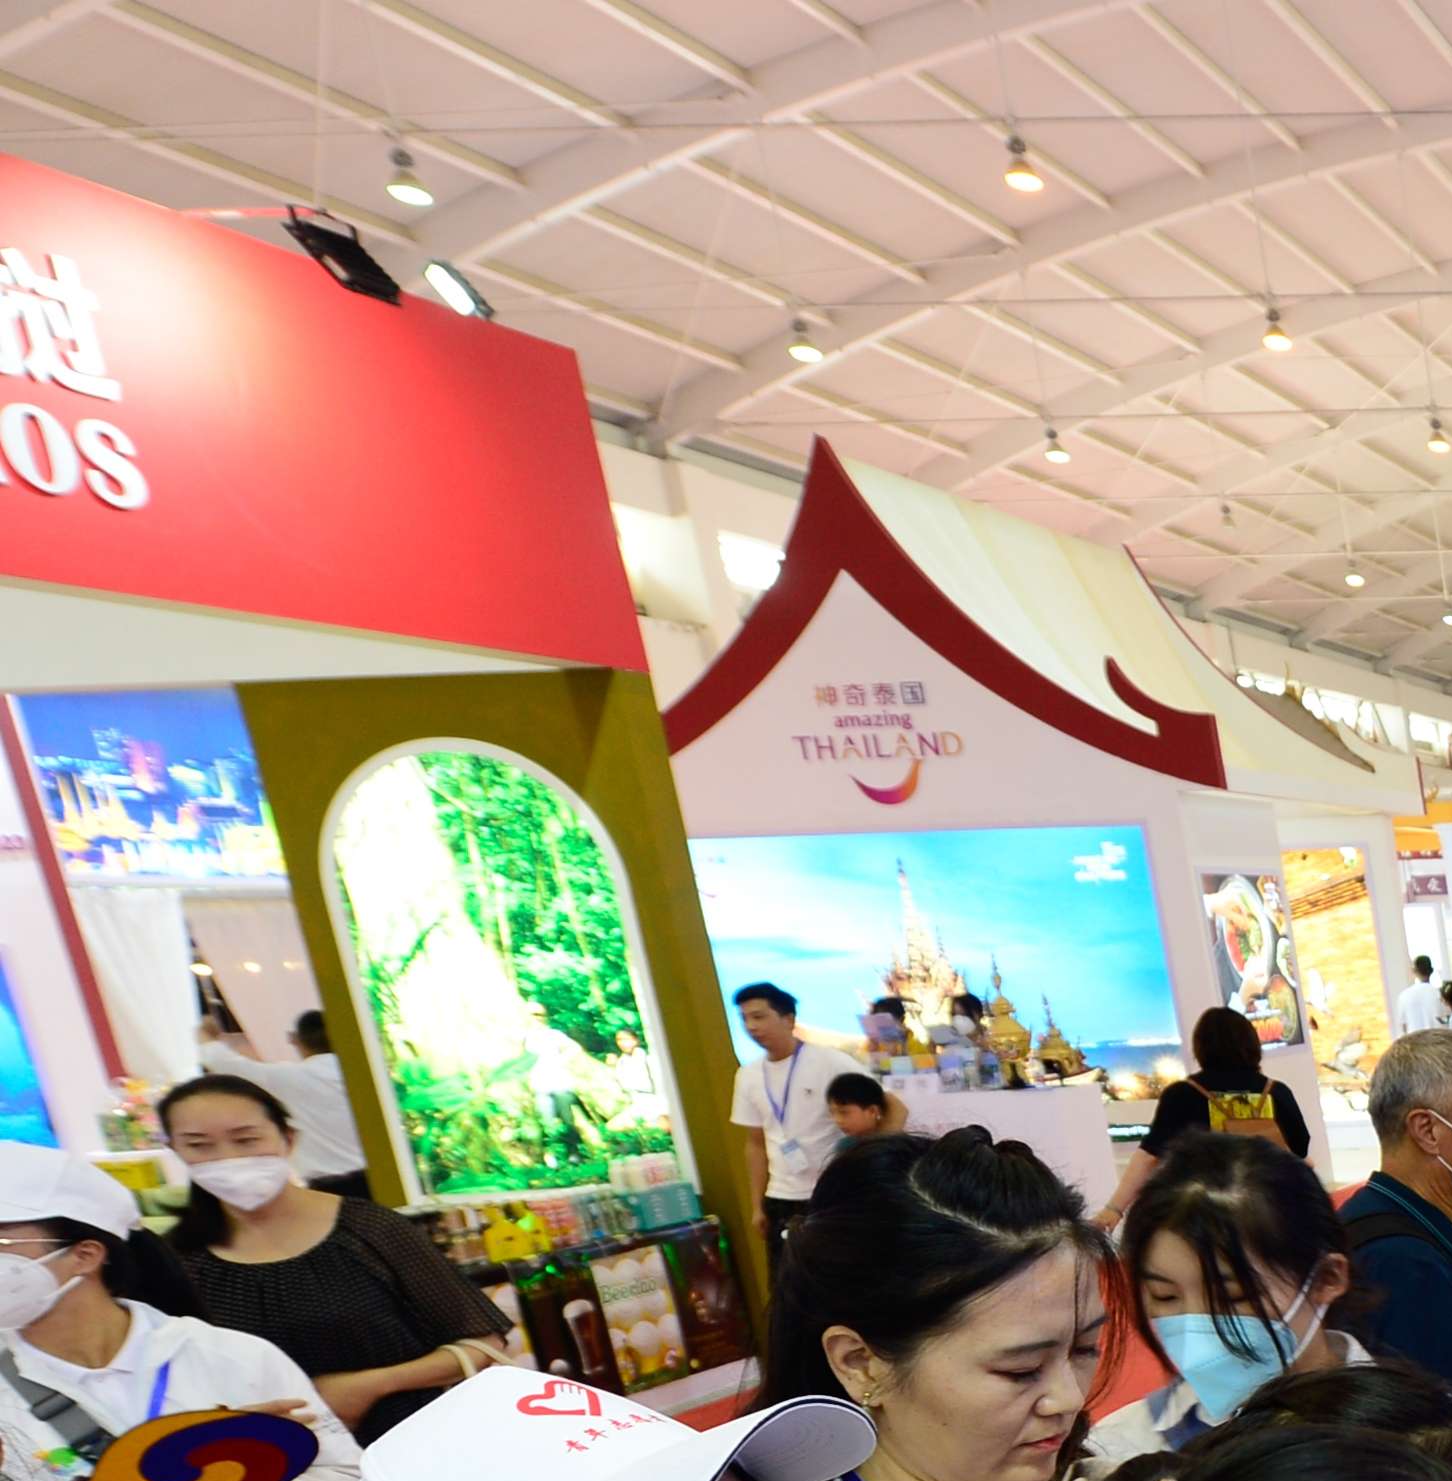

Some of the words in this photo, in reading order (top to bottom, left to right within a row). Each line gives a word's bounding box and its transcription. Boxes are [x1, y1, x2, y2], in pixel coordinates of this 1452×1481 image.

[0, 402, 151, 511] OS
[815, 681, 926, 706] 神奇泰国
[834, 710, 914, 730] amazing
[792, 730, 963, 761] THAILAND
